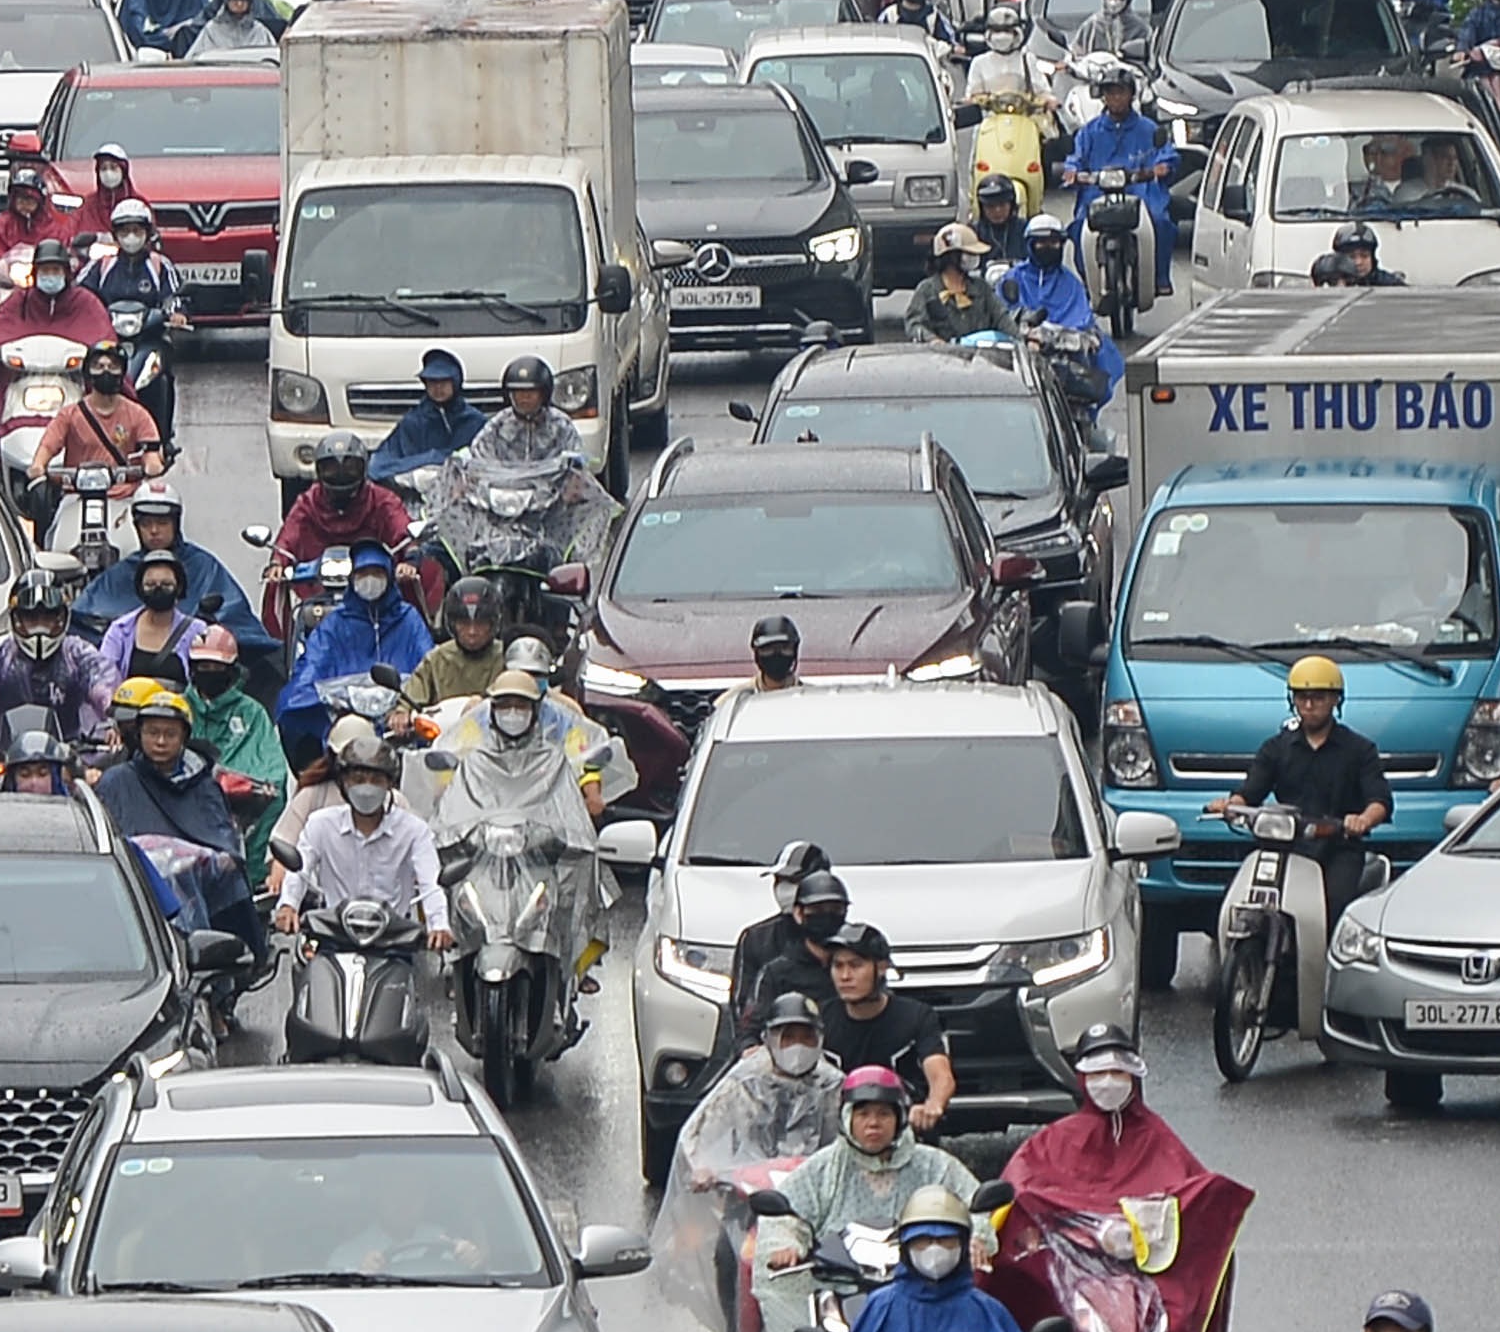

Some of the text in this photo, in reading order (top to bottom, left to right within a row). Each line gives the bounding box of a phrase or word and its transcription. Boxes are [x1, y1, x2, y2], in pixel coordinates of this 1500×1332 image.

[1208, 371, 1493, 431] XE THƯ BÁO
